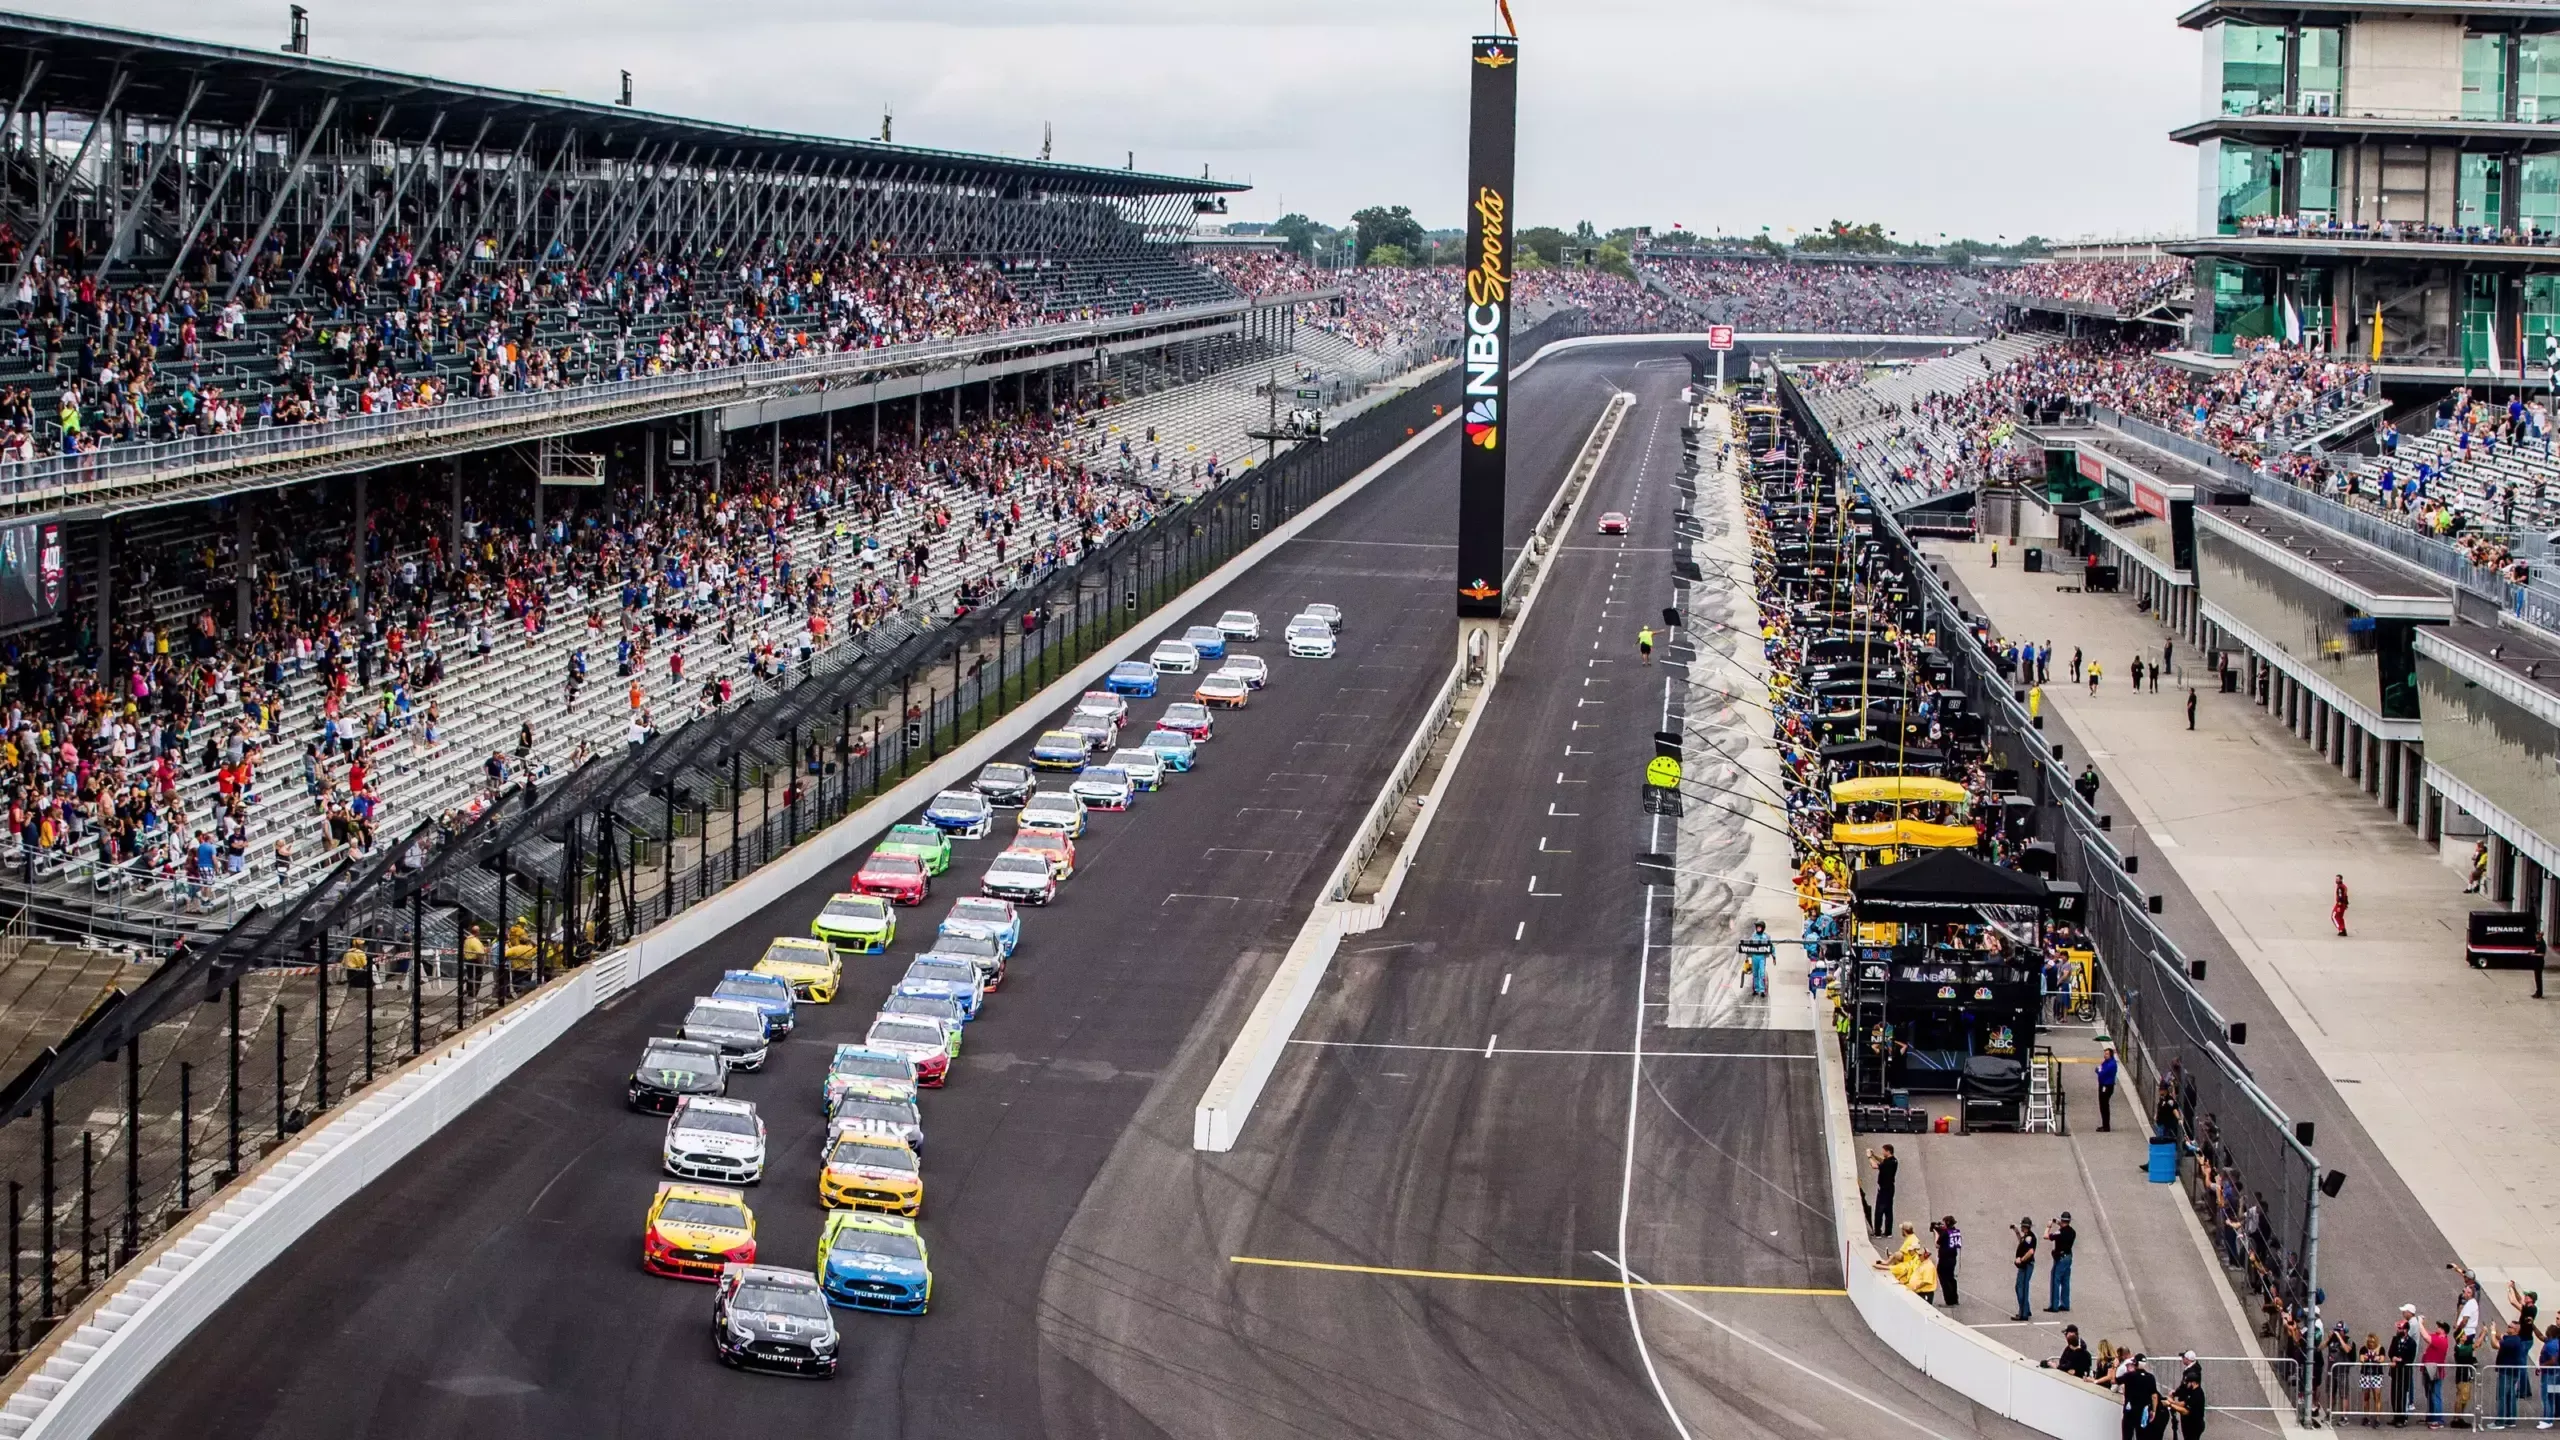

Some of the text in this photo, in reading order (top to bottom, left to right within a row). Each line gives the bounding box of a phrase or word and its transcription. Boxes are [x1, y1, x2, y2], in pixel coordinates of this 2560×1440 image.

[1466, 186, 1511, 396] NBC Sports
[1803, 567, 1826, 576] FedEx
[2059, 896, 2075, 909] 18
[2486, 925, 2524, 933] MENARDS
[1988, 1038, 2014, 1049] NBC
[662, 1221, 740, 1236] PENNZOIL
[677, 1259, 721, 1270] MUSTANG
[853, 1290, 896, 1301] MUSTANG
[757, 1352, 803, 1364] MUSTANG
